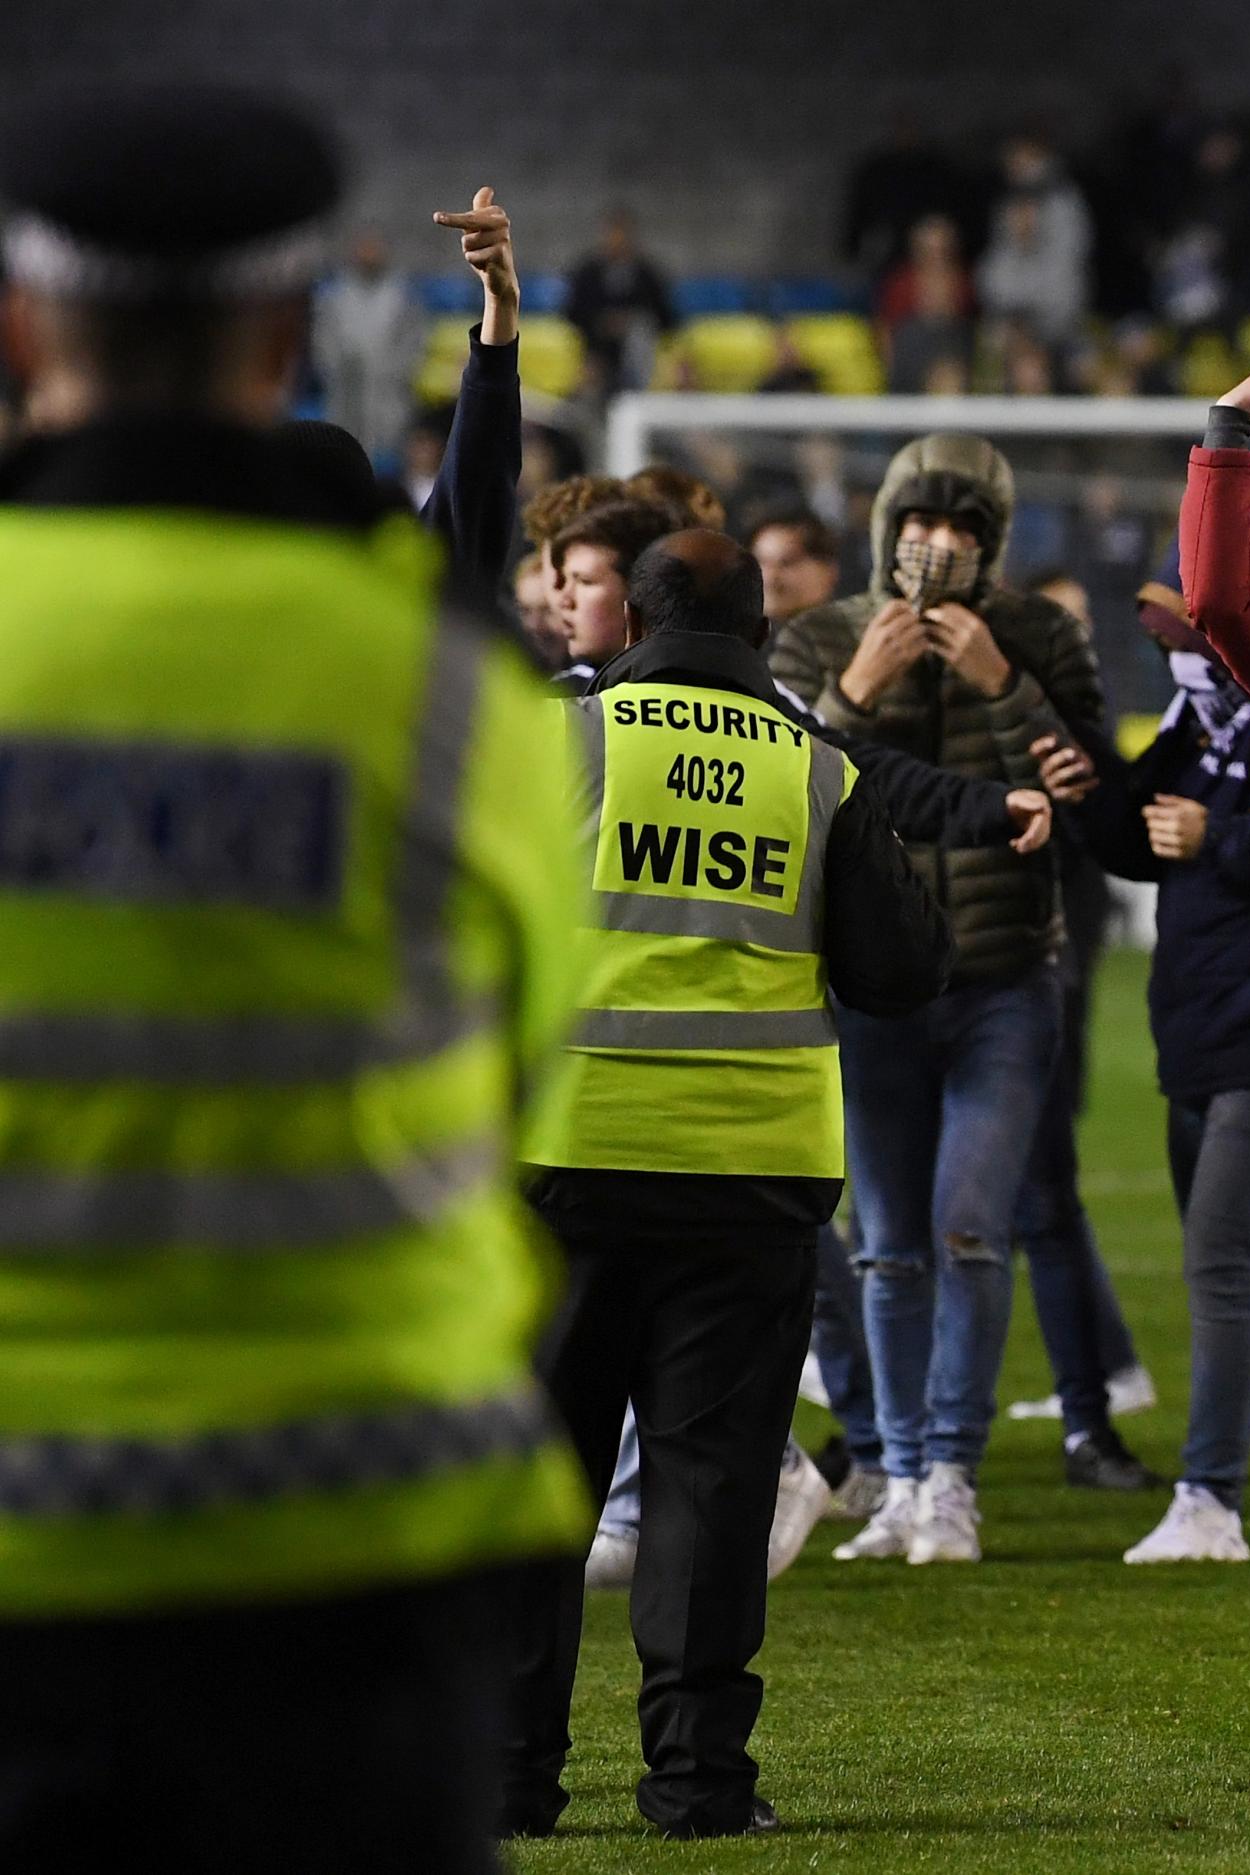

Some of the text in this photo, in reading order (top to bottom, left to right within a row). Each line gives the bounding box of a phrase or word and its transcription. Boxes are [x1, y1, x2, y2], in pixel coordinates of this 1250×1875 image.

[614, 699, 804, 748] SECURITY
[667, 754, 745, 806] 4032
[618, 822, 790, 898] WISE
